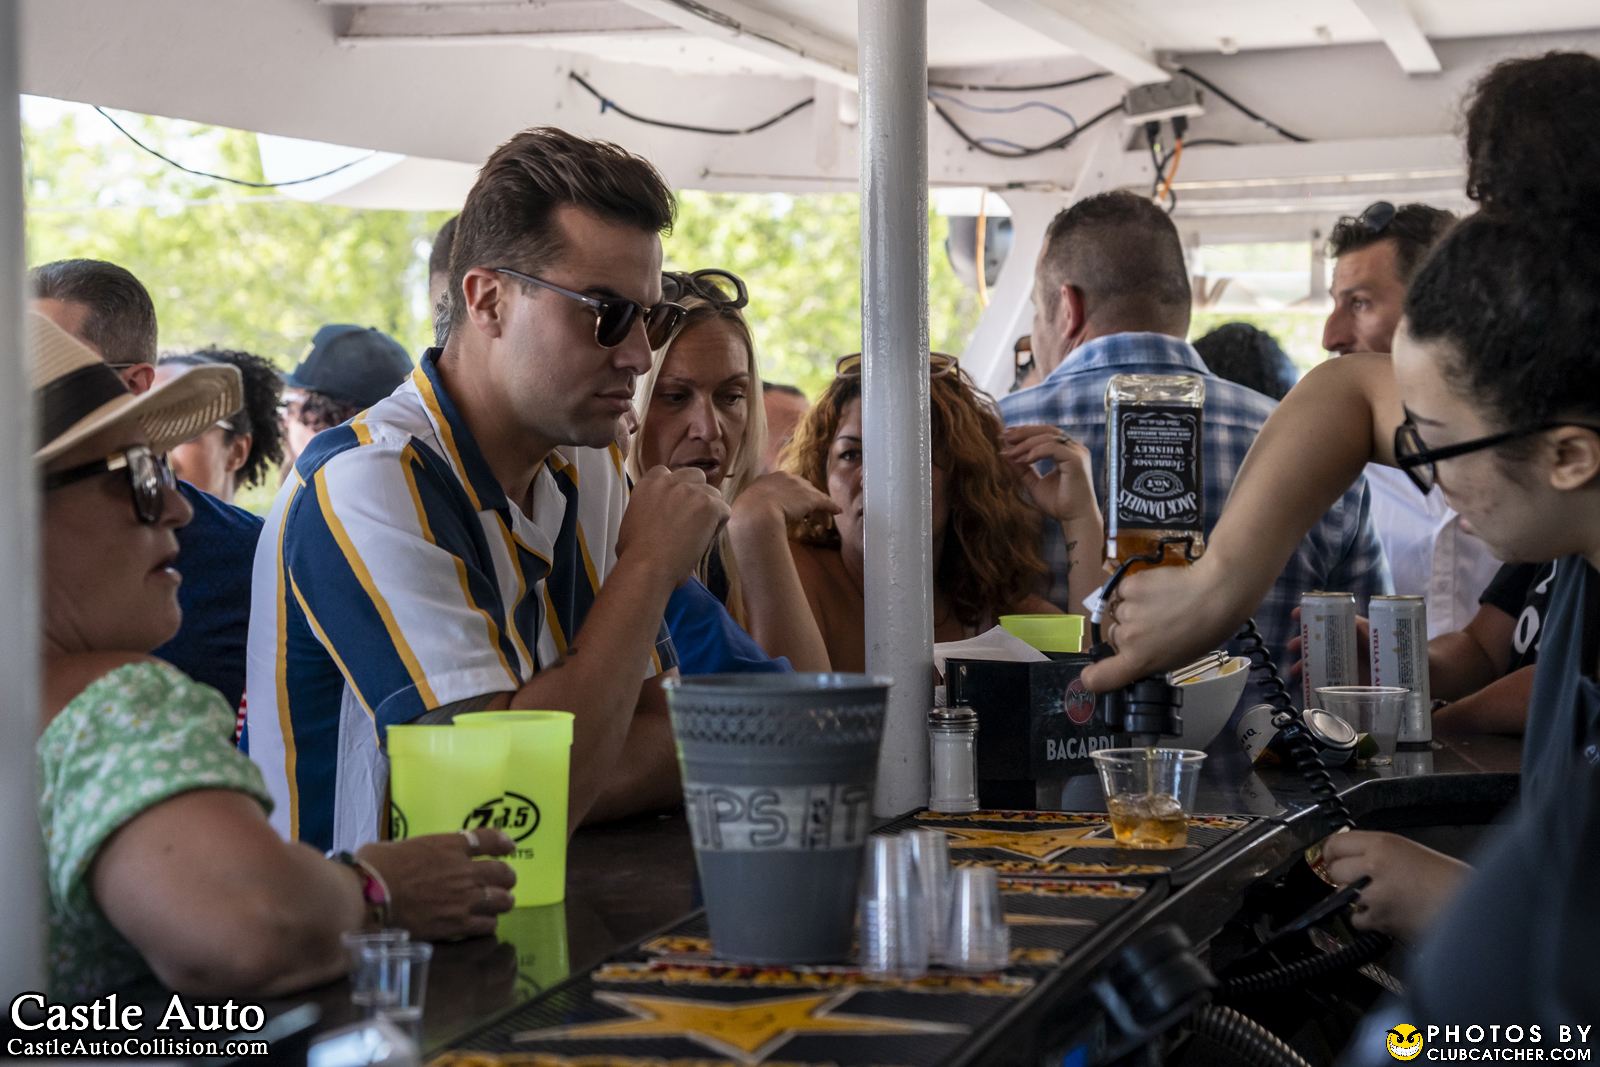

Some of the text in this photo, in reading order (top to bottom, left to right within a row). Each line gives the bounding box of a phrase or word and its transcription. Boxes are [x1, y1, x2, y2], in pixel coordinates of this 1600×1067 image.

[1133, 445, 1185, 454] WHISKEY
[1132, 458, 1185, 472] Tennessee
[1166, 492, 1198, 515] JACK
[1372, 628, 1380, 663] STELLA
[1046, 735, 1115, 760] BACARDI
